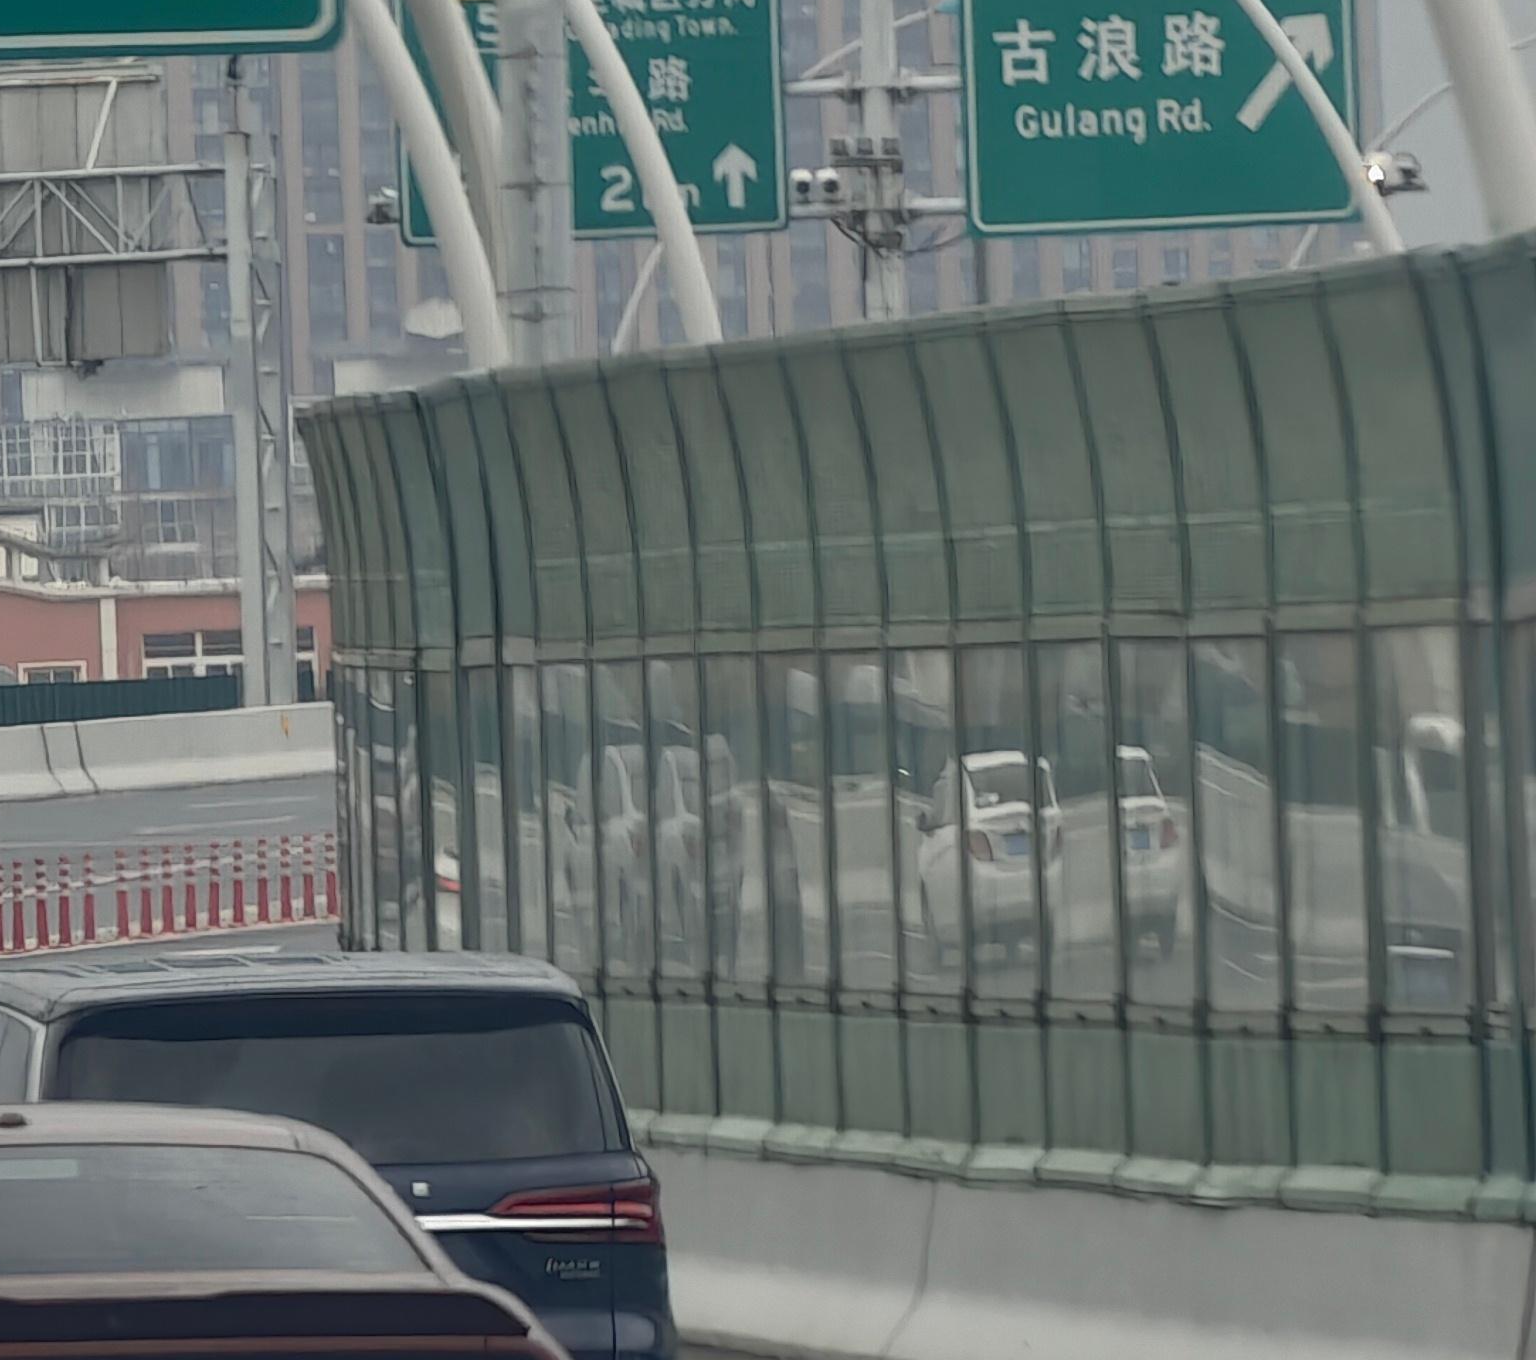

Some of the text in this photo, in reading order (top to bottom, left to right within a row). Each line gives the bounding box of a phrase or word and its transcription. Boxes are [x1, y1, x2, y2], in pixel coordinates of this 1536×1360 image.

[992, 10, 1226, 86] 古浪路
[1014, 97, 1213, 145] Gulang Rd.
